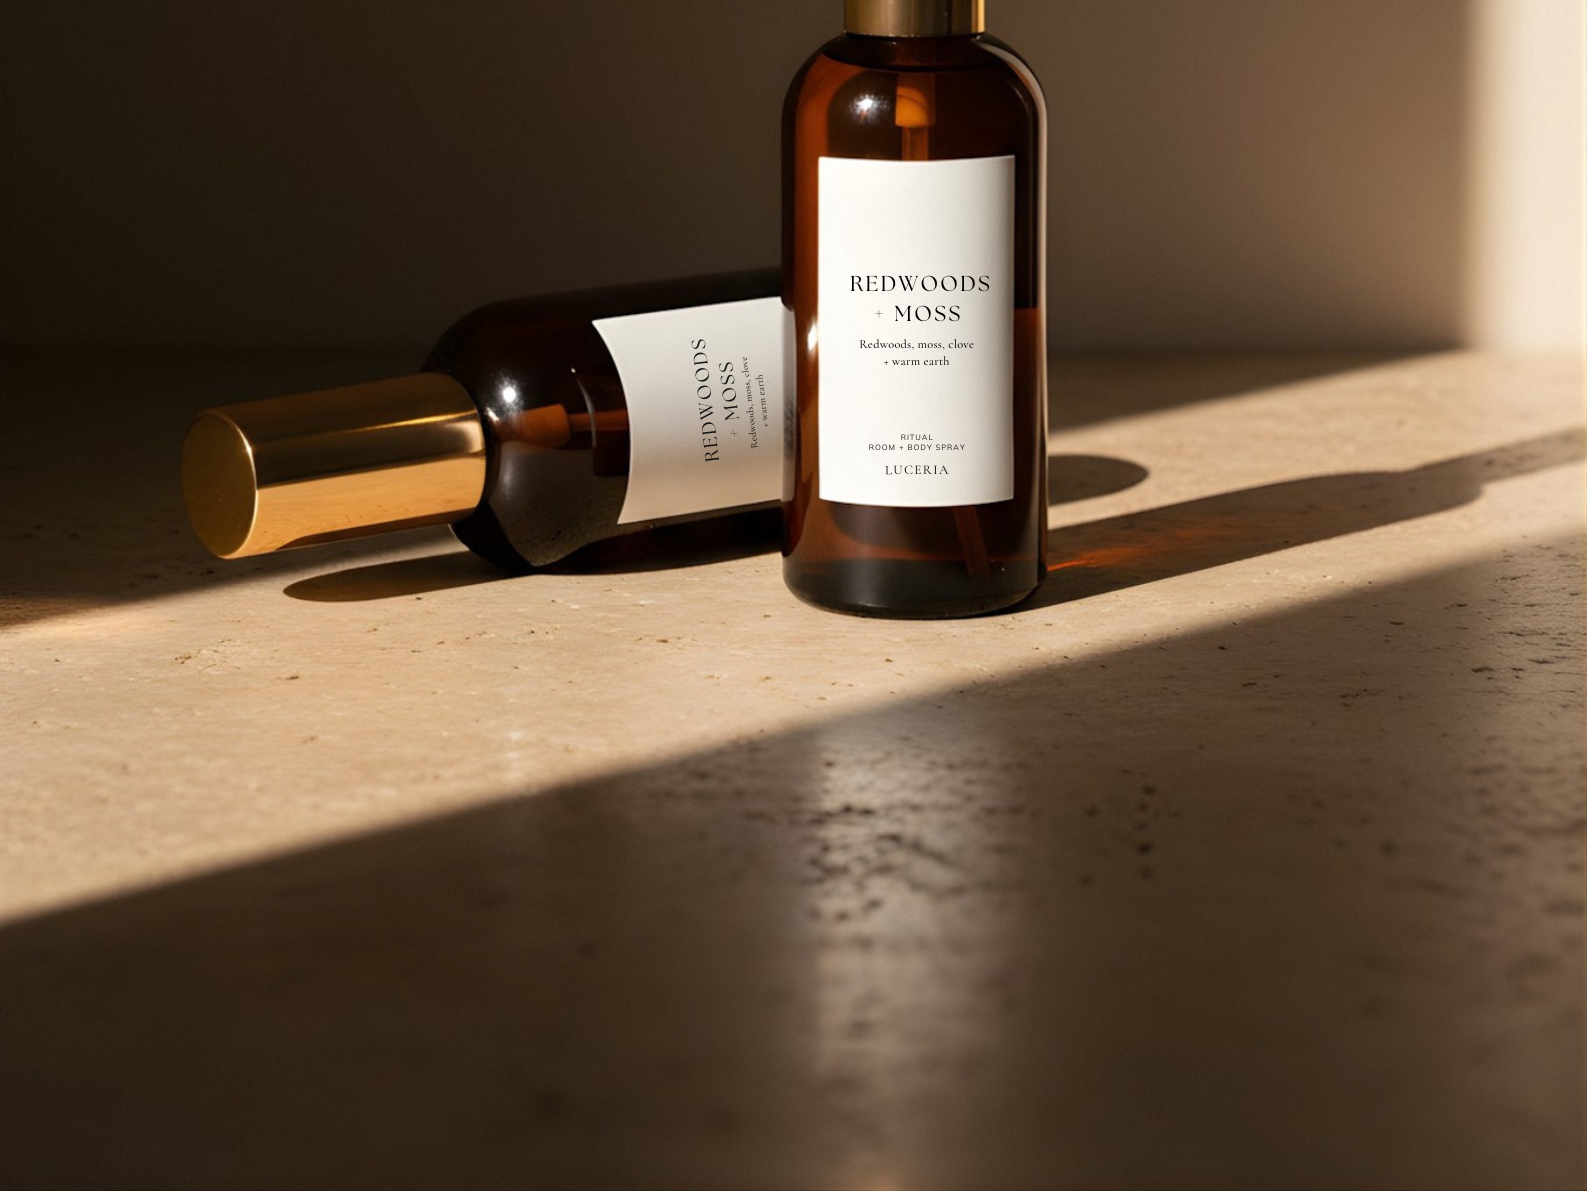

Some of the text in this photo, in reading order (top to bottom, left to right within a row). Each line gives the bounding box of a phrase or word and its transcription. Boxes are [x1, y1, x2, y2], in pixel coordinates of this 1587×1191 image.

[850, 275, 991, 292] REDWOODS
[895, 305, 961, 322] MOSS
[859, 339, 975, 350] Redwoods, moss, clove
[923, 356, 950, 366] earth
[718, 361, 740, 421] MOSS
[756, 374, 765, 396] earth
[691, 338, 720, 462] REDWOODS
[742, 356, 758, 449] Redwoods, moss, clove
[759, 397, 768, 421] warm
[885, 465, 949, 475] LUCERIA
